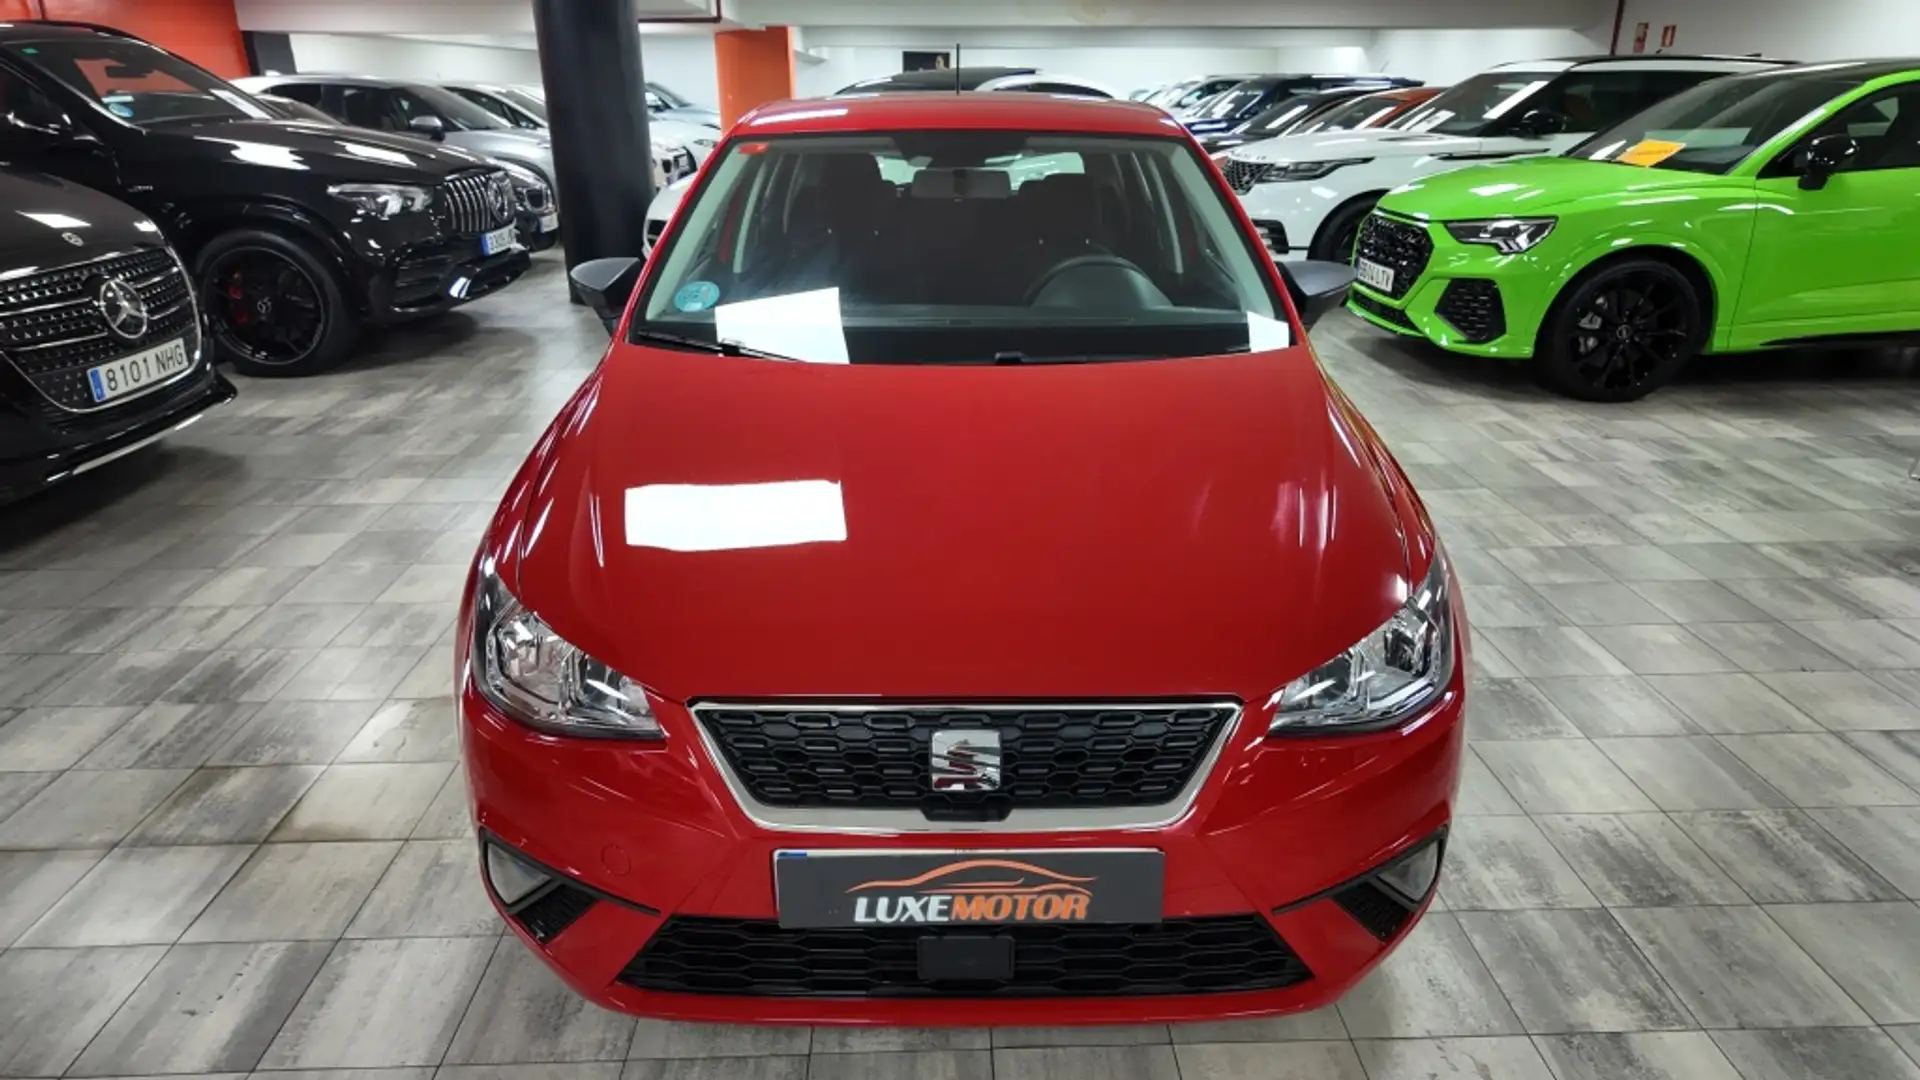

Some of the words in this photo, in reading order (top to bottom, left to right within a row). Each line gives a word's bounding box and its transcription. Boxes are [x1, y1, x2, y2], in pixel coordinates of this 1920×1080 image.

[105, 356, 151, 391] 8101
[154, 344, 184, 375] NHG
[854, 894, 1090, 923] LUXEMOTOR
